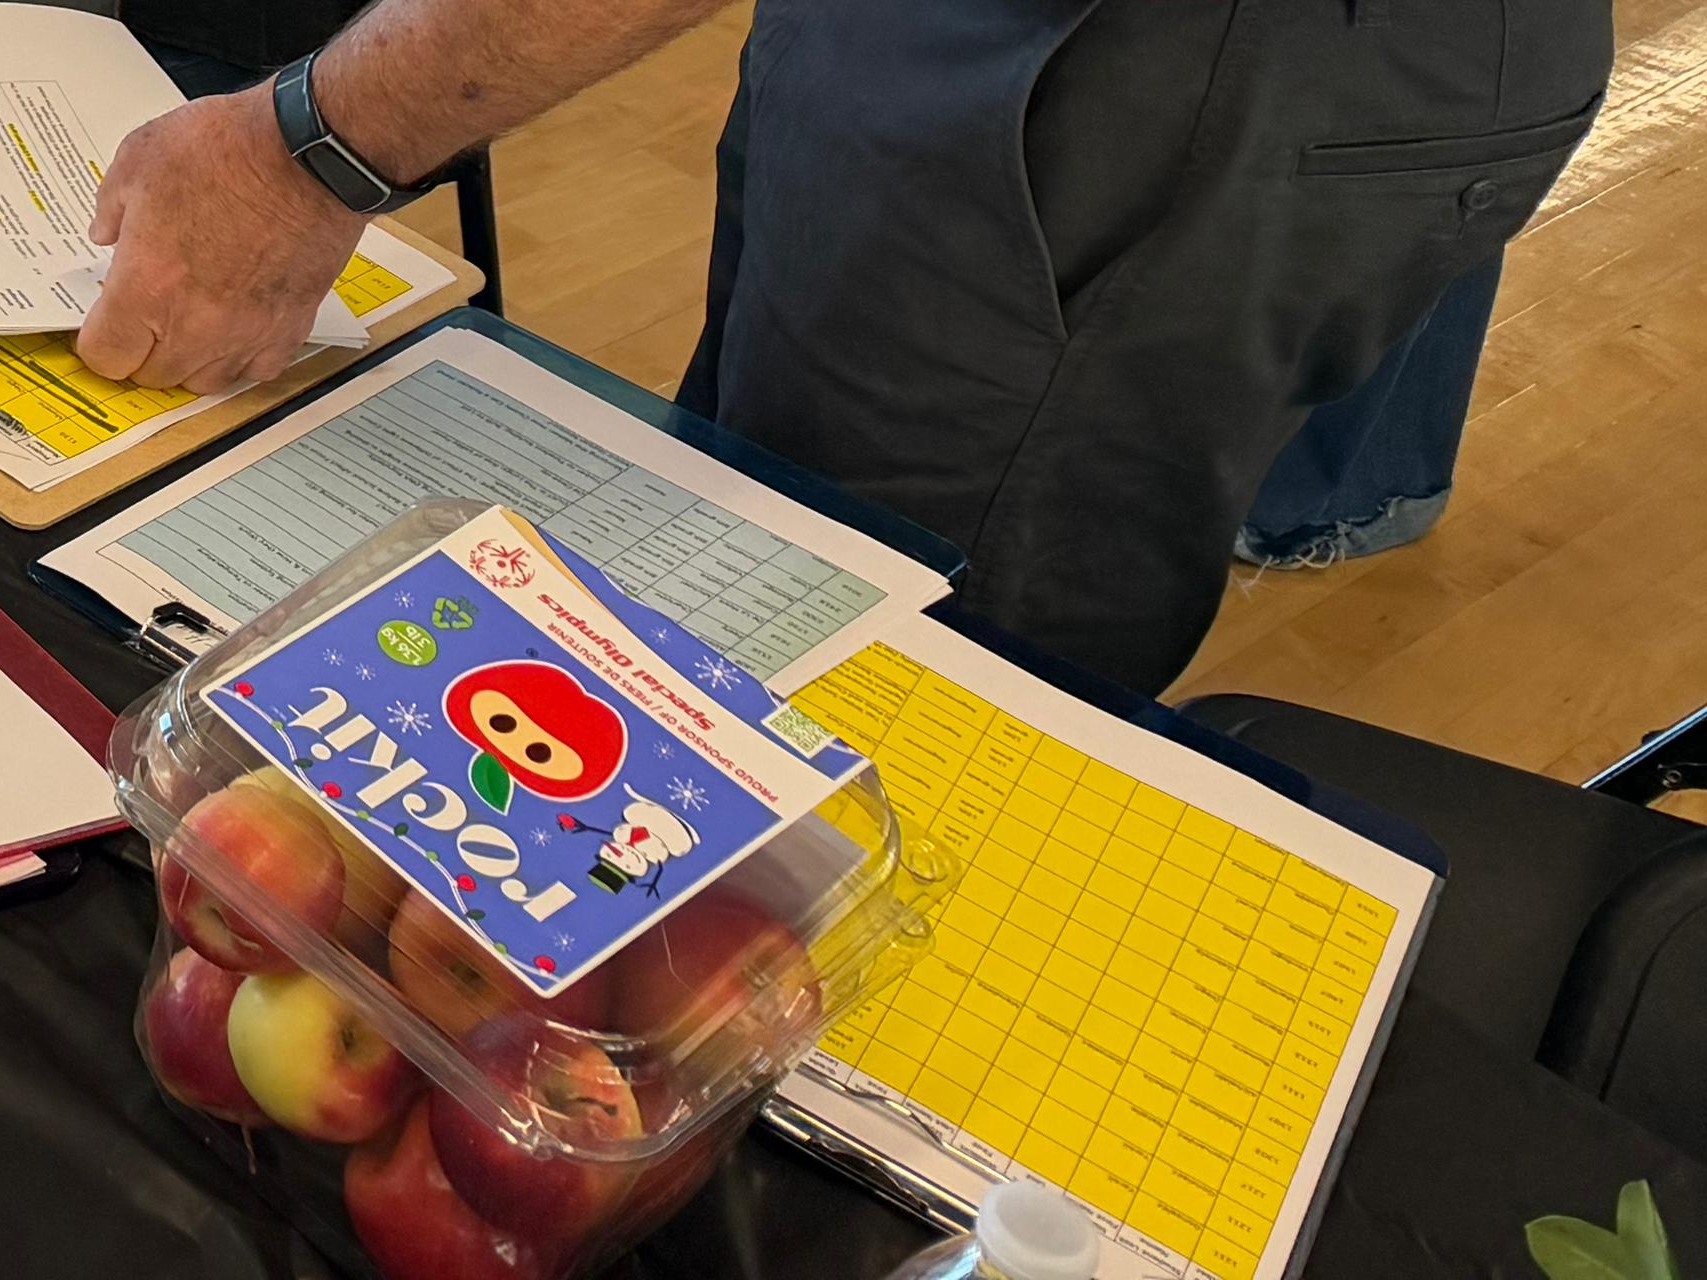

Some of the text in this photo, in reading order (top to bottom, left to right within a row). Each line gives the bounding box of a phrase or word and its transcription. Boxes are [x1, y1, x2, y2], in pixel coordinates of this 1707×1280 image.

[379, 626, 407, 646] kg
[404, 624, 422, 640] lb
[537, 593, 632, 667] Olympics
[546, 622, 603, 667] SOUTENIR
[601, 665, 621, 681] DE
[618, 678, 653, 706] FIERS
[632, 669, 715, 730] Special
[657, 711, 678, 725] OF
[676, 724, 735, 769] SPONSOR
[734, 767, 778, 802] PROUD
[288, 686, 578, 923] rockit
